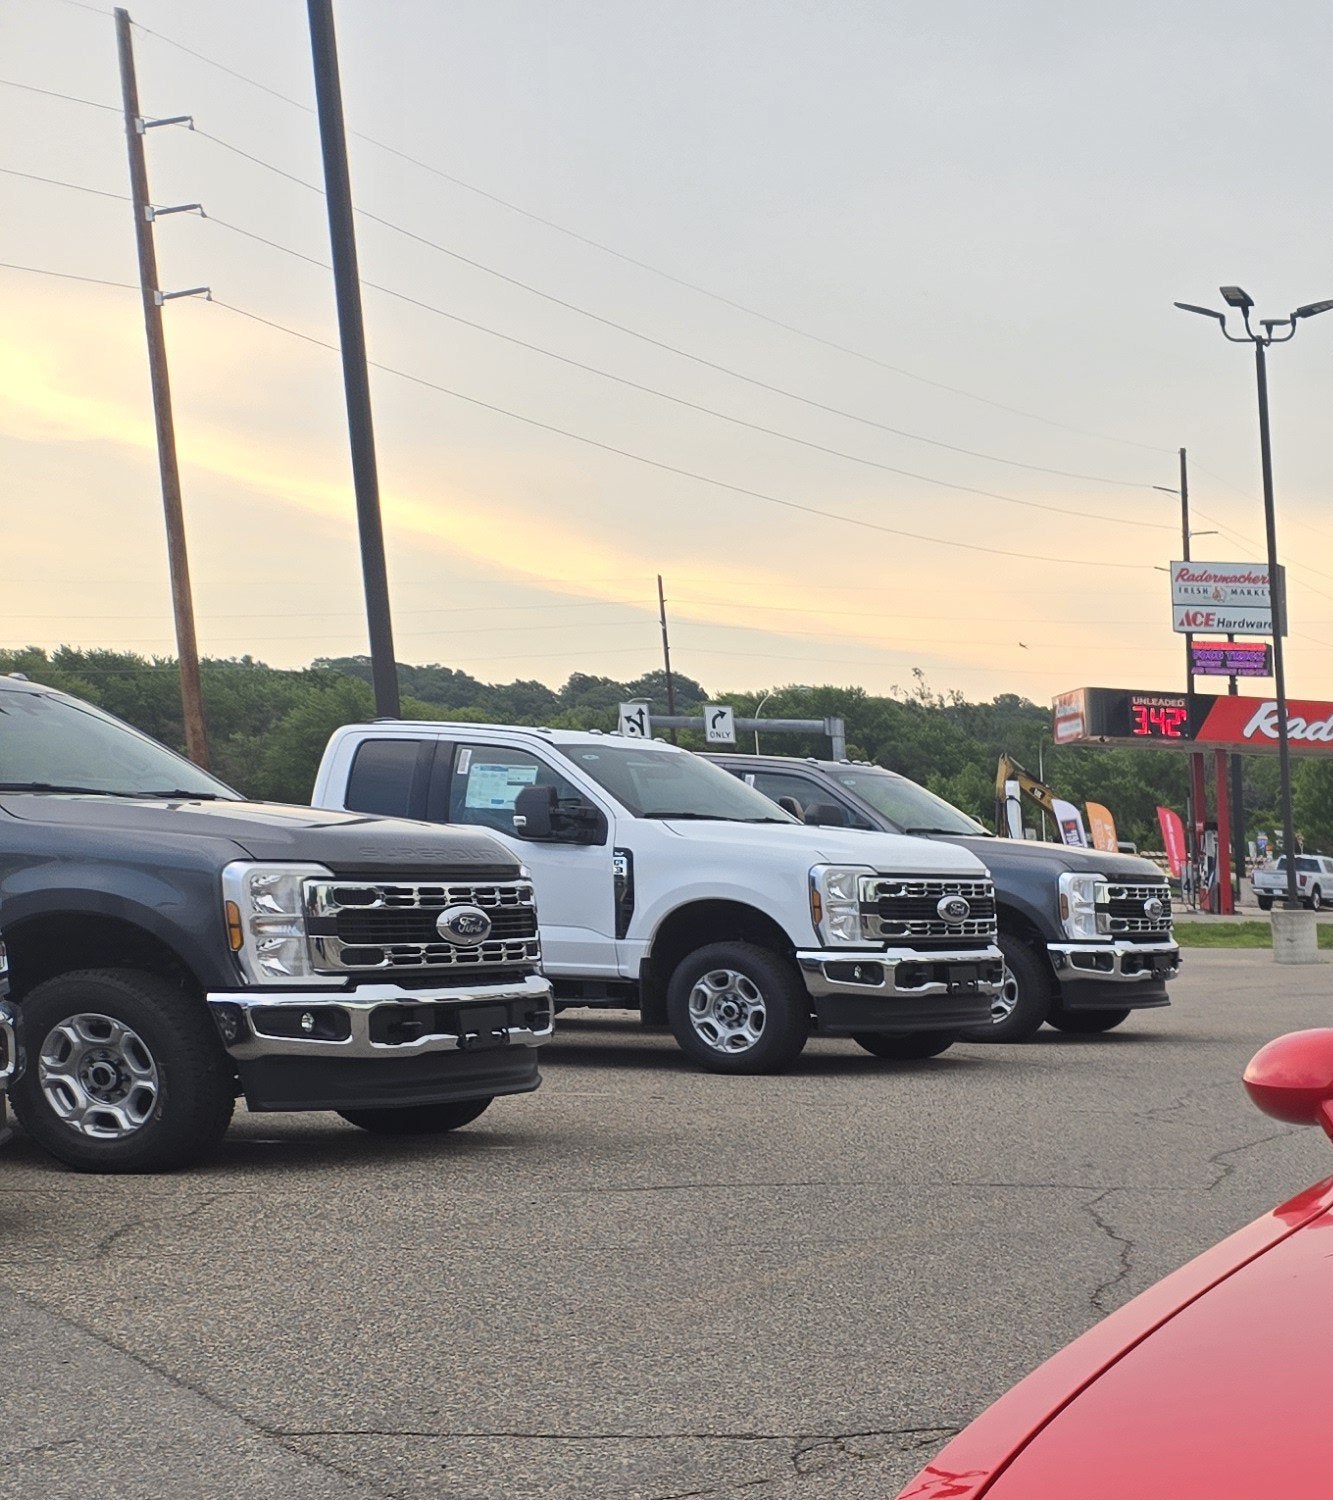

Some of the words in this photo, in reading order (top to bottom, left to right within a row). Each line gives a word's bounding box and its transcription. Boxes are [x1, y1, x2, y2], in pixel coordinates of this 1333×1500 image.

[1178, 587, 1209, 595] FRESH
[1230, 588, 1269, 597] MARKE
[1178, 609, 1216, 628] ACE
[1132, 696, 1185, 707] UNLEADED
[710, 731, 731, 739] ONLY
[457, 916, 483, 933] Ford
